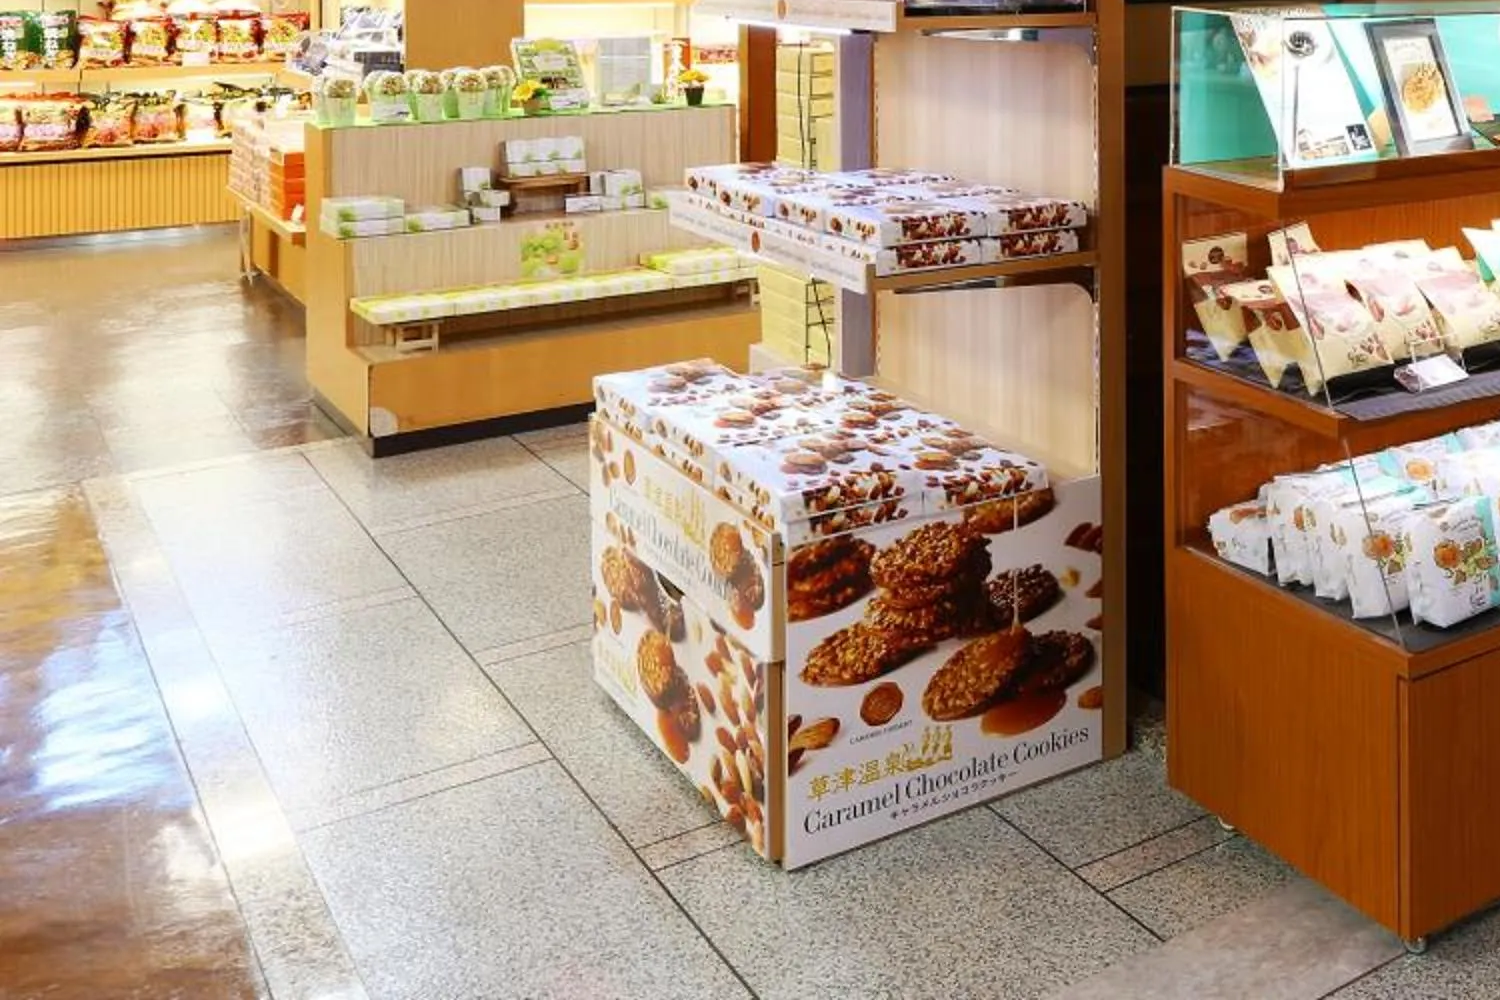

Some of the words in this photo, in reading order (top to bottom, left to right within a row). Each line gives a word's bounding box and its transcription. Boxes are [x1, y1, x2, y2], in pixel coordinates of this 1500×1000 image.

[803, 783, 901, 835] Caramel
[904, 751, 1010, 801] Chocolate
[1012, 725, 1090, 766] Cookies
